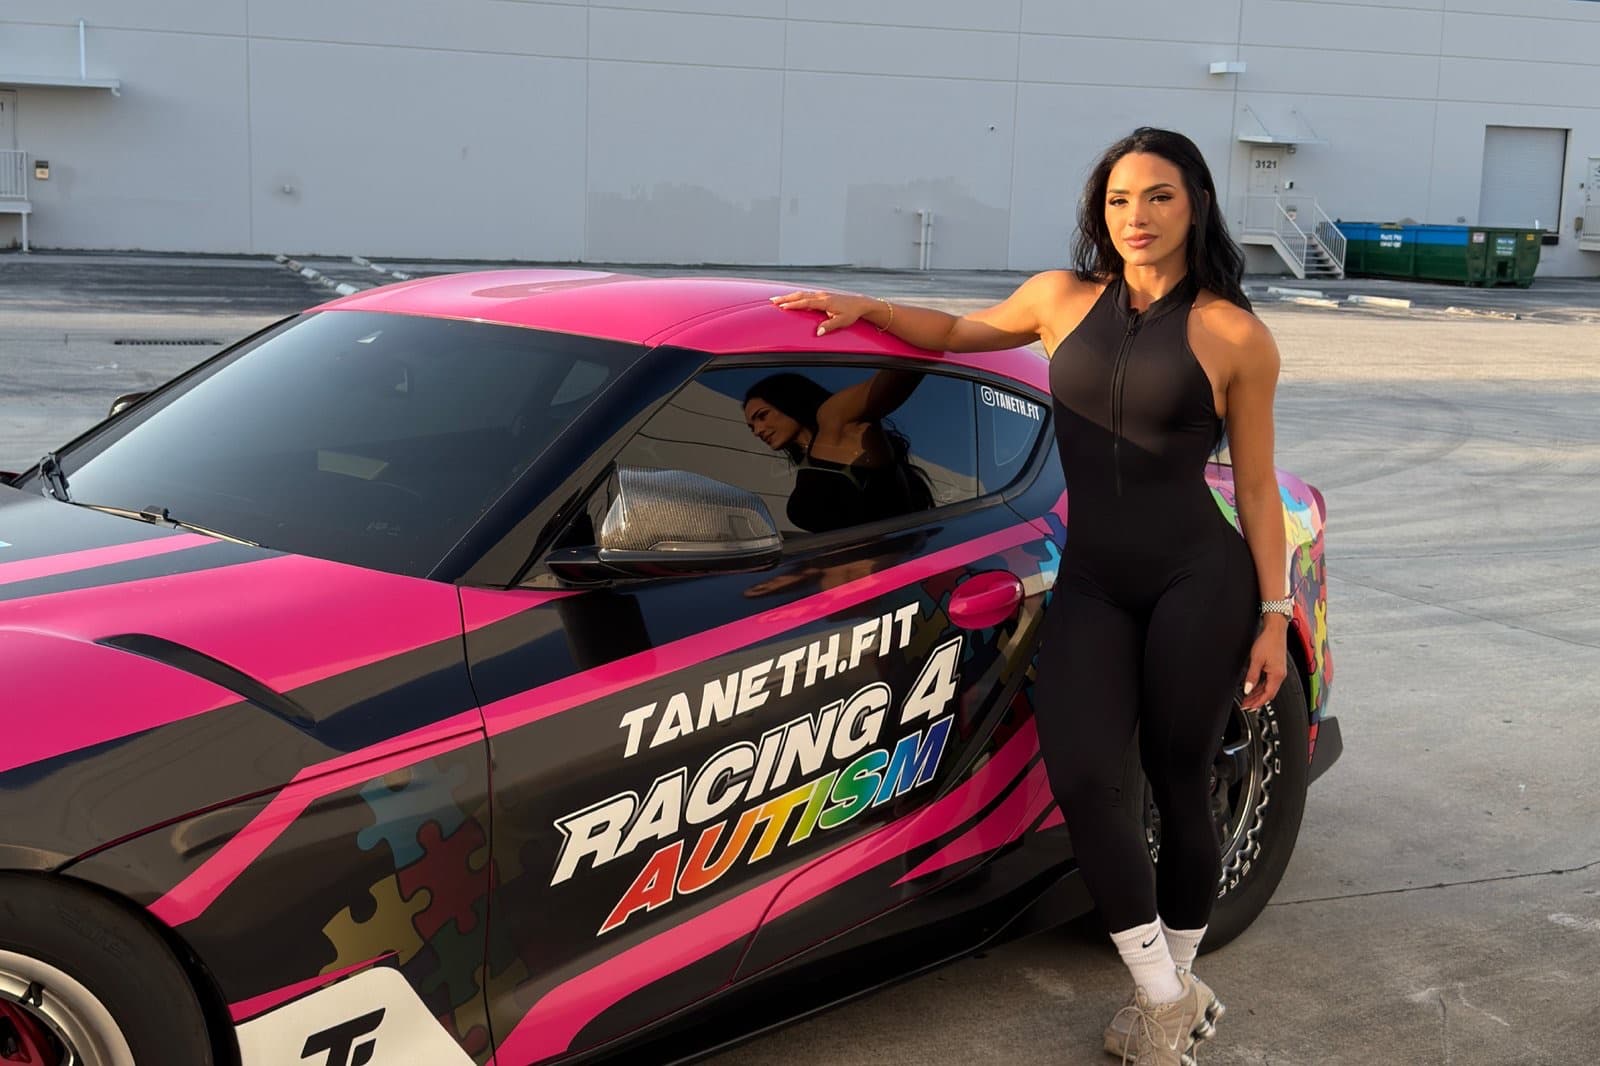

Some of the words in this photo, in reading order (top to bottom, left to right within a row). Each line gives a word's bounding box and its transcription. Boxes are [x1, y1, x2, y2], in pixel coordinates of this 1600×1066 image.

[1255, 159, 1277, 169] 3121
[551, 682, 891, 886] RACING
[900, 636, 963, 726] 4
[619, 602, 919, 757] TANETH.FIT
[597, 715, 954, 936] AUTISM
